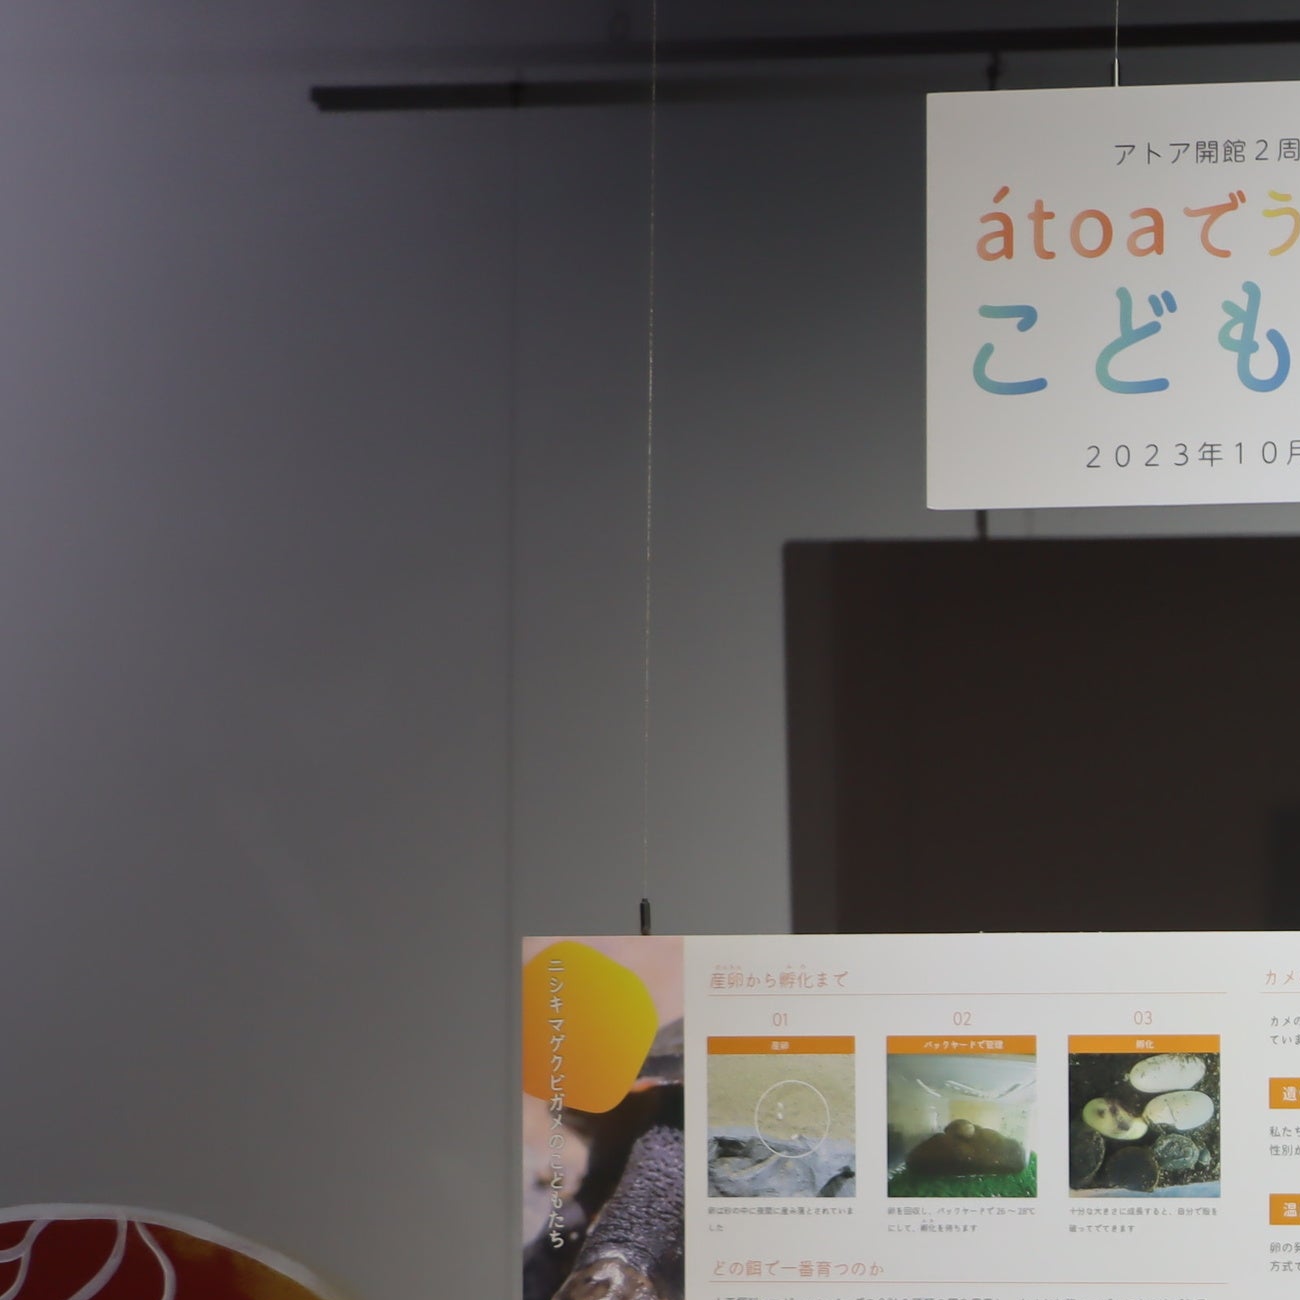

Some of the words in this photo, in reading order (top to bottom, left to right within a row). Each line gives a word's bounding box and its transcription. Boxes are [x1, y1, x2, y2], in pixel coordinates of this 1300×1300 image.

[709, 970, 849, 989] 産卵から孵化まで
[772, 1013, 788, 1027] 01
[953, 1011, 972, 1026] 02
[1134, 1010, 1153, 1025] 03
[711, 1259, 885, 1278] どの餌で一番育つのか
